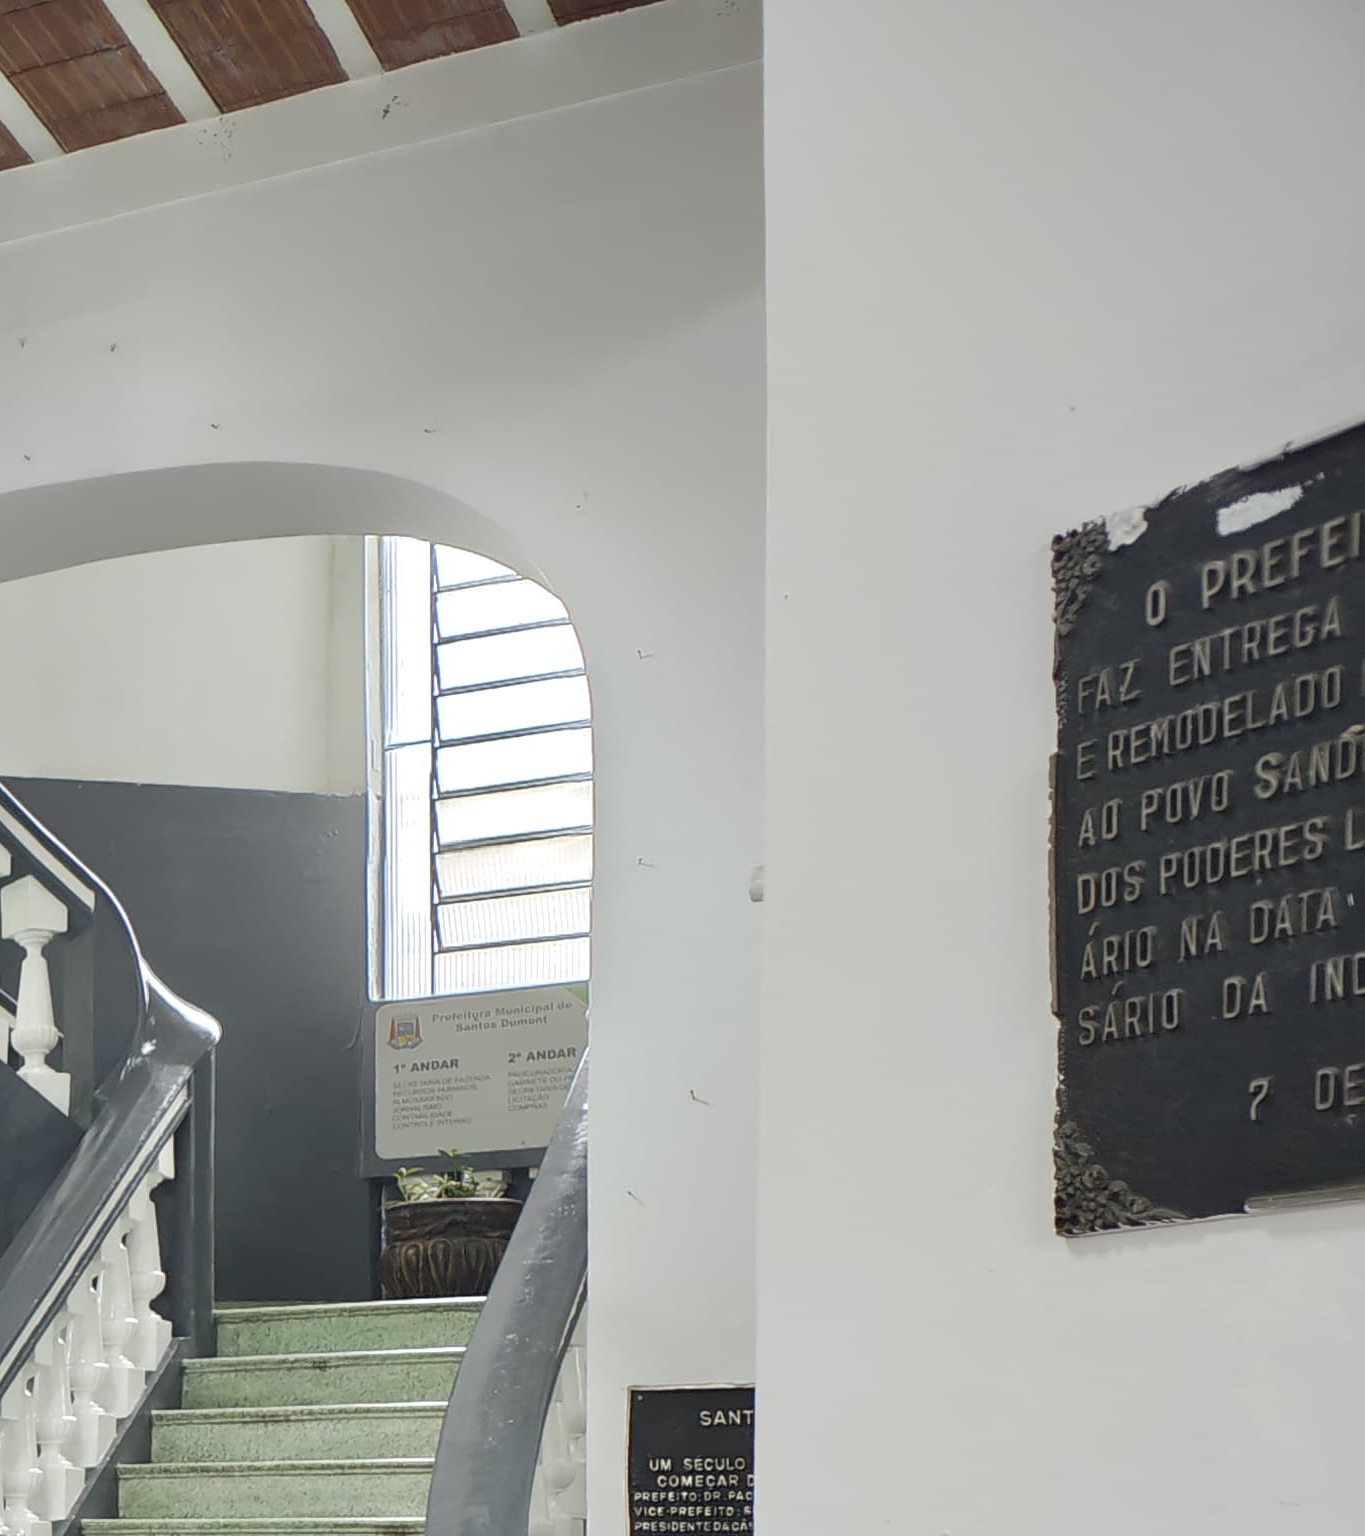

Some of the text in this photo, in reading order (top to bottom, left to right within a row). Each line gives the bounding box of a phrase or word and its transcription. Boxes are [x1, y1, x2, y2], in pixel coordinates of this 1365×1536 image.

[1145, 579, 1168, 627] O
[1077, 658, 1141, 714] FAZ
[1170, 595, 1343, 687] ENTREGA
[1077, 738, 1098, 780] E
[1108, 665, 1345, 770] REMODELADO
[1079, 733, 1365, 847] AO POVO SAND
[1077, 859, 1145, 914] DOS
[1160, 815, 1330, 895] PODERES
[1081, 887, 1339, 979] ÁRIO NA DATA
[456, 1015, 548, 1033] Santos Dumont
[495, 1002, 554, 1017] Municipal
[1078, 981, 1184, 1045] SÁRIO
[1224, 972, 1269, 1019] DA
[410, 1058, 459, 1073] ANDAR
[526, 1046, 576, 1062] ANDAR
[1249, 1076, 1273, 1121] 7
[649, 1455, 745, 1472] UM SÉCULO
[657, 1474, 739, 1490] COMEÇAR
[634, 1519, 753, 1532] PRESIDENTE DA CÂ
